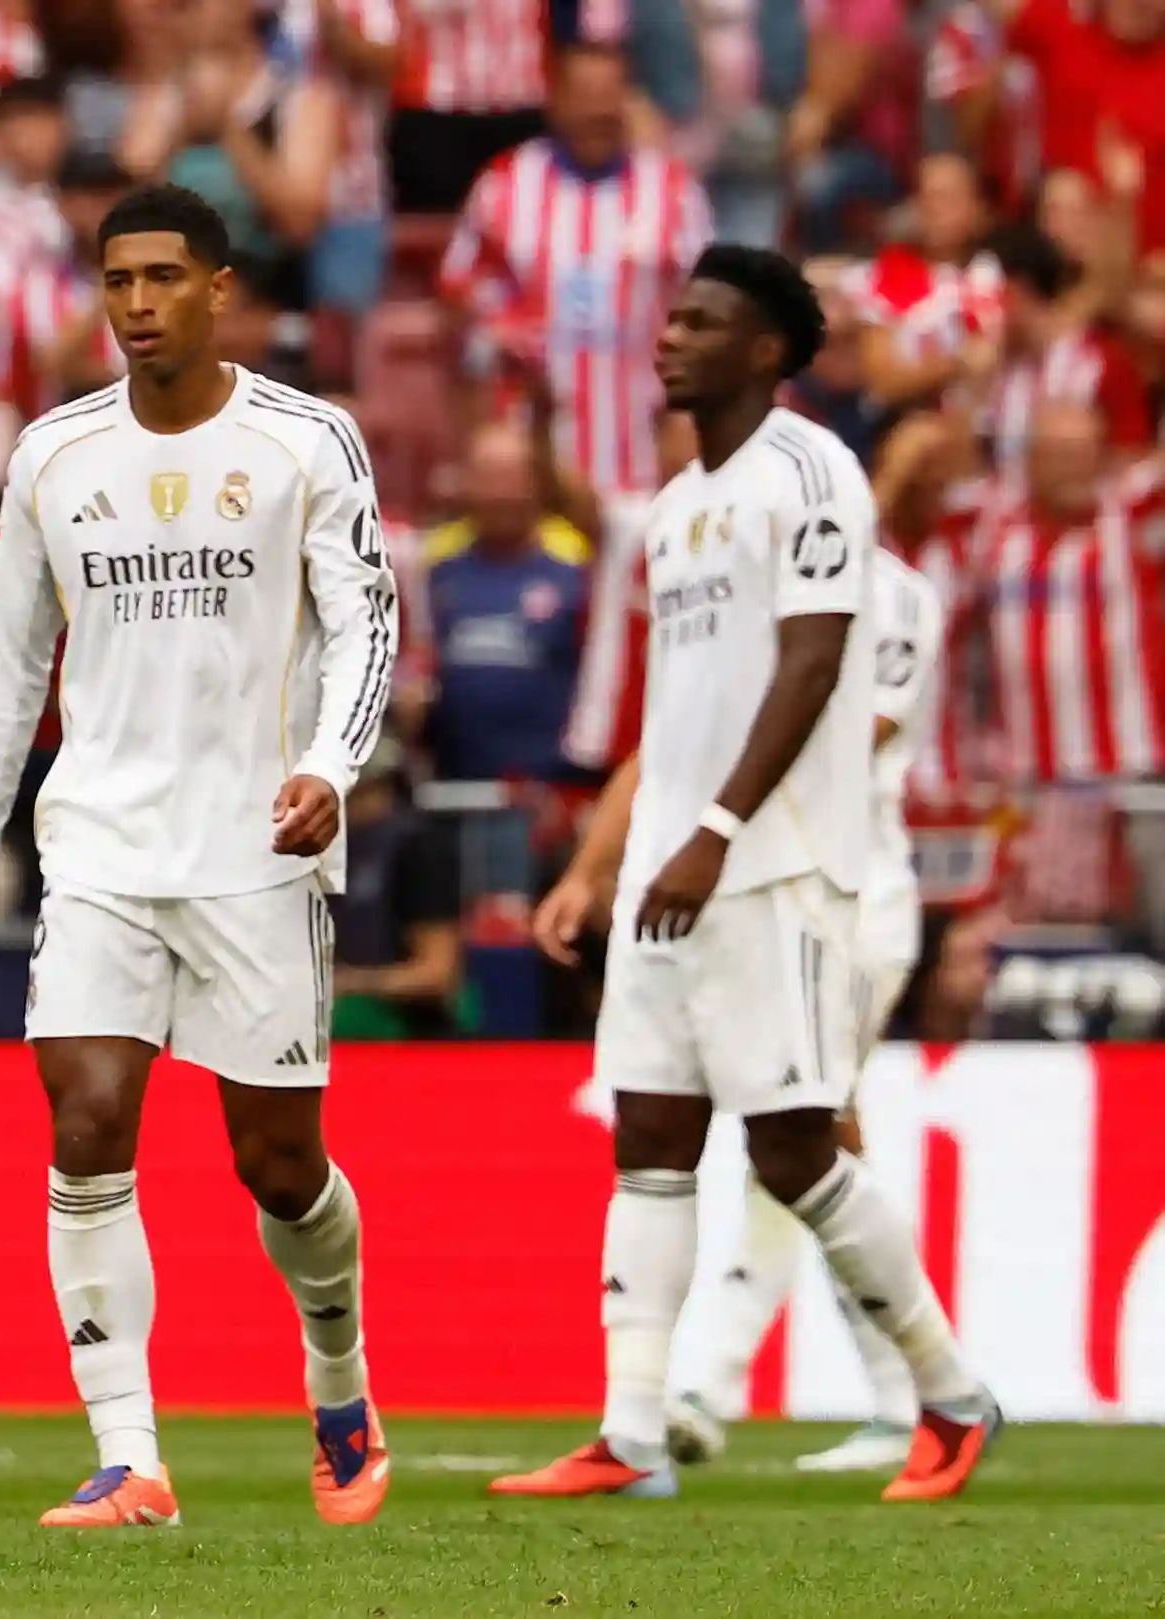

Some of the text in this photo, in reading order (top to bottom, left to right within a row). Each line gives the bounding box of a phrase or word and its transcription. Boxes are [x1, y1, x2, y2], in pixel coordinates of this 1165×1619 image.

[81, 543, 255, 588] Emirates
[112, 586, 227, 624] FLY BETTER
